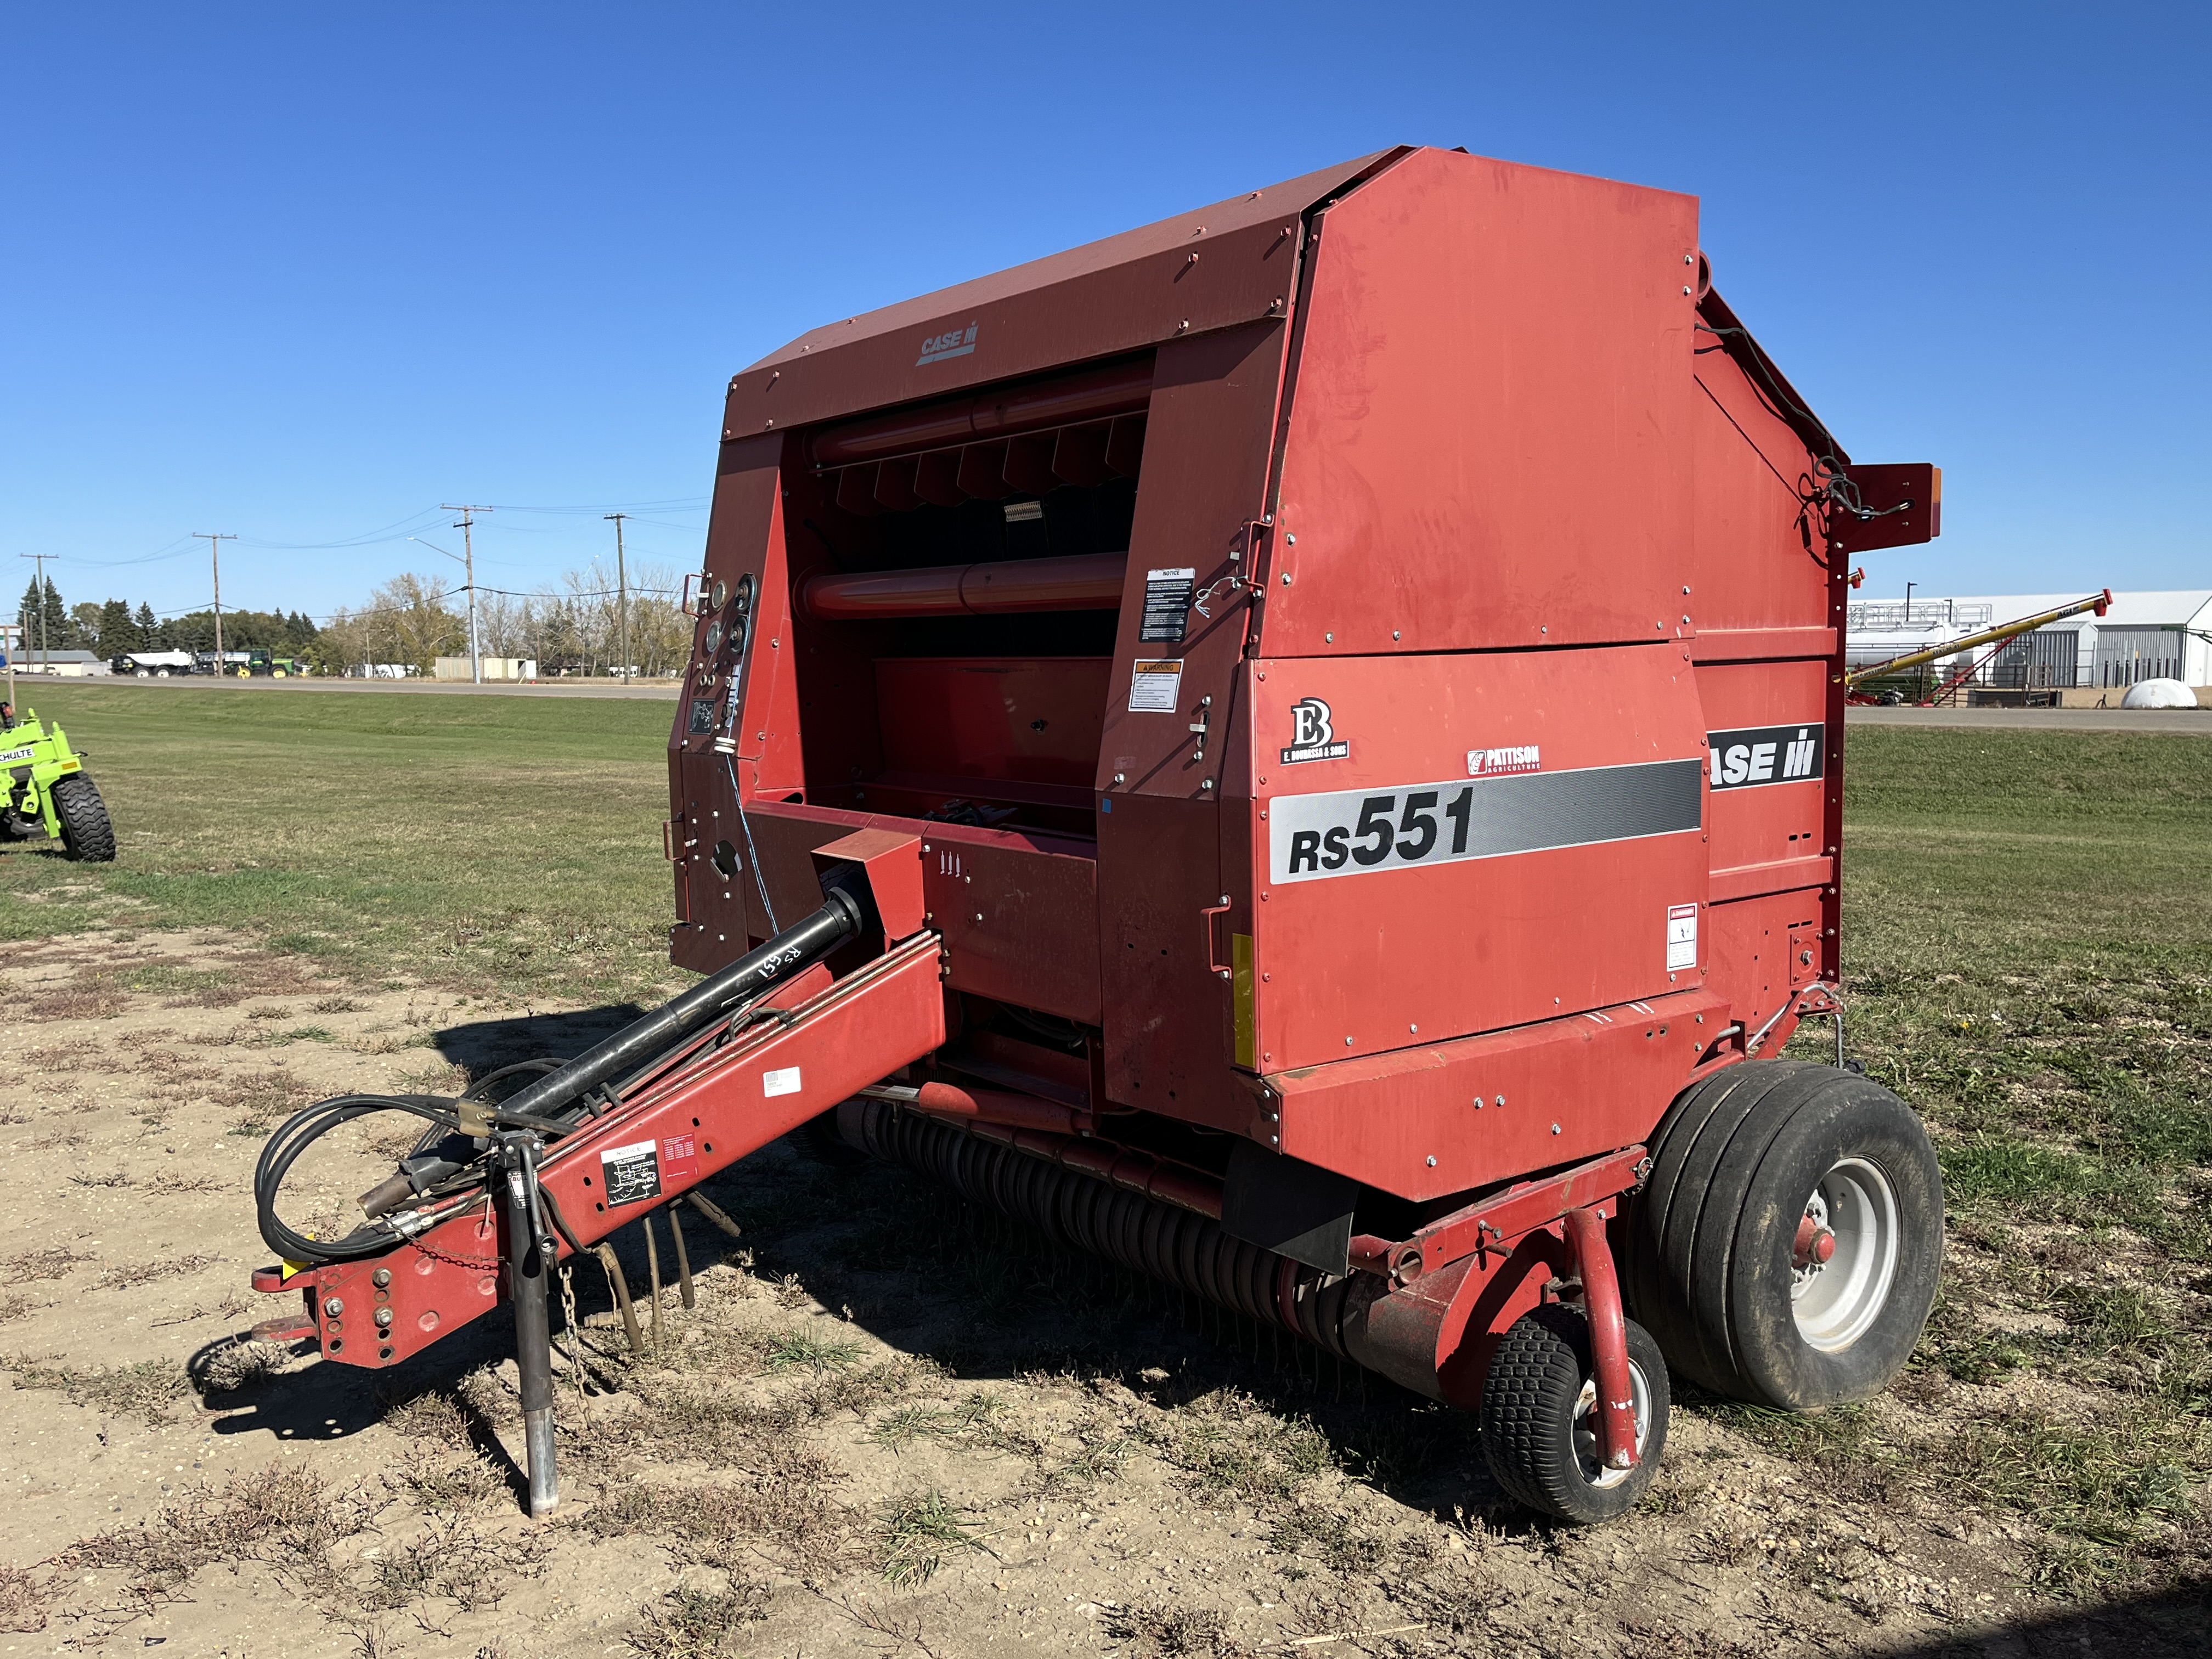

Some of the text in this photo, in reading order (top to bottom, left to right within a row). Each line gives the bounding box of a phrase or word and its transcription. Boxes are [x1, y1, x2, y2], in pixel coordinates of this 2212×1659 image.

[922, 329, 962, 354] CASE
[0, 749, 32, 761] CHULTE
[1324, 747, 1329, 757] &
[1330, 745, 1346, 756] SONS
[1487, 745, 1539, 766] PATTISON
[1487, 763, 1541, 773] AGRICULTURE
[1709, 742, 1777, 785] ASE
[1289, 787, 1474, 873] RS551
[785, 945, 801, 964] RS
[616, 1146, 641, 1156] NOTICE
